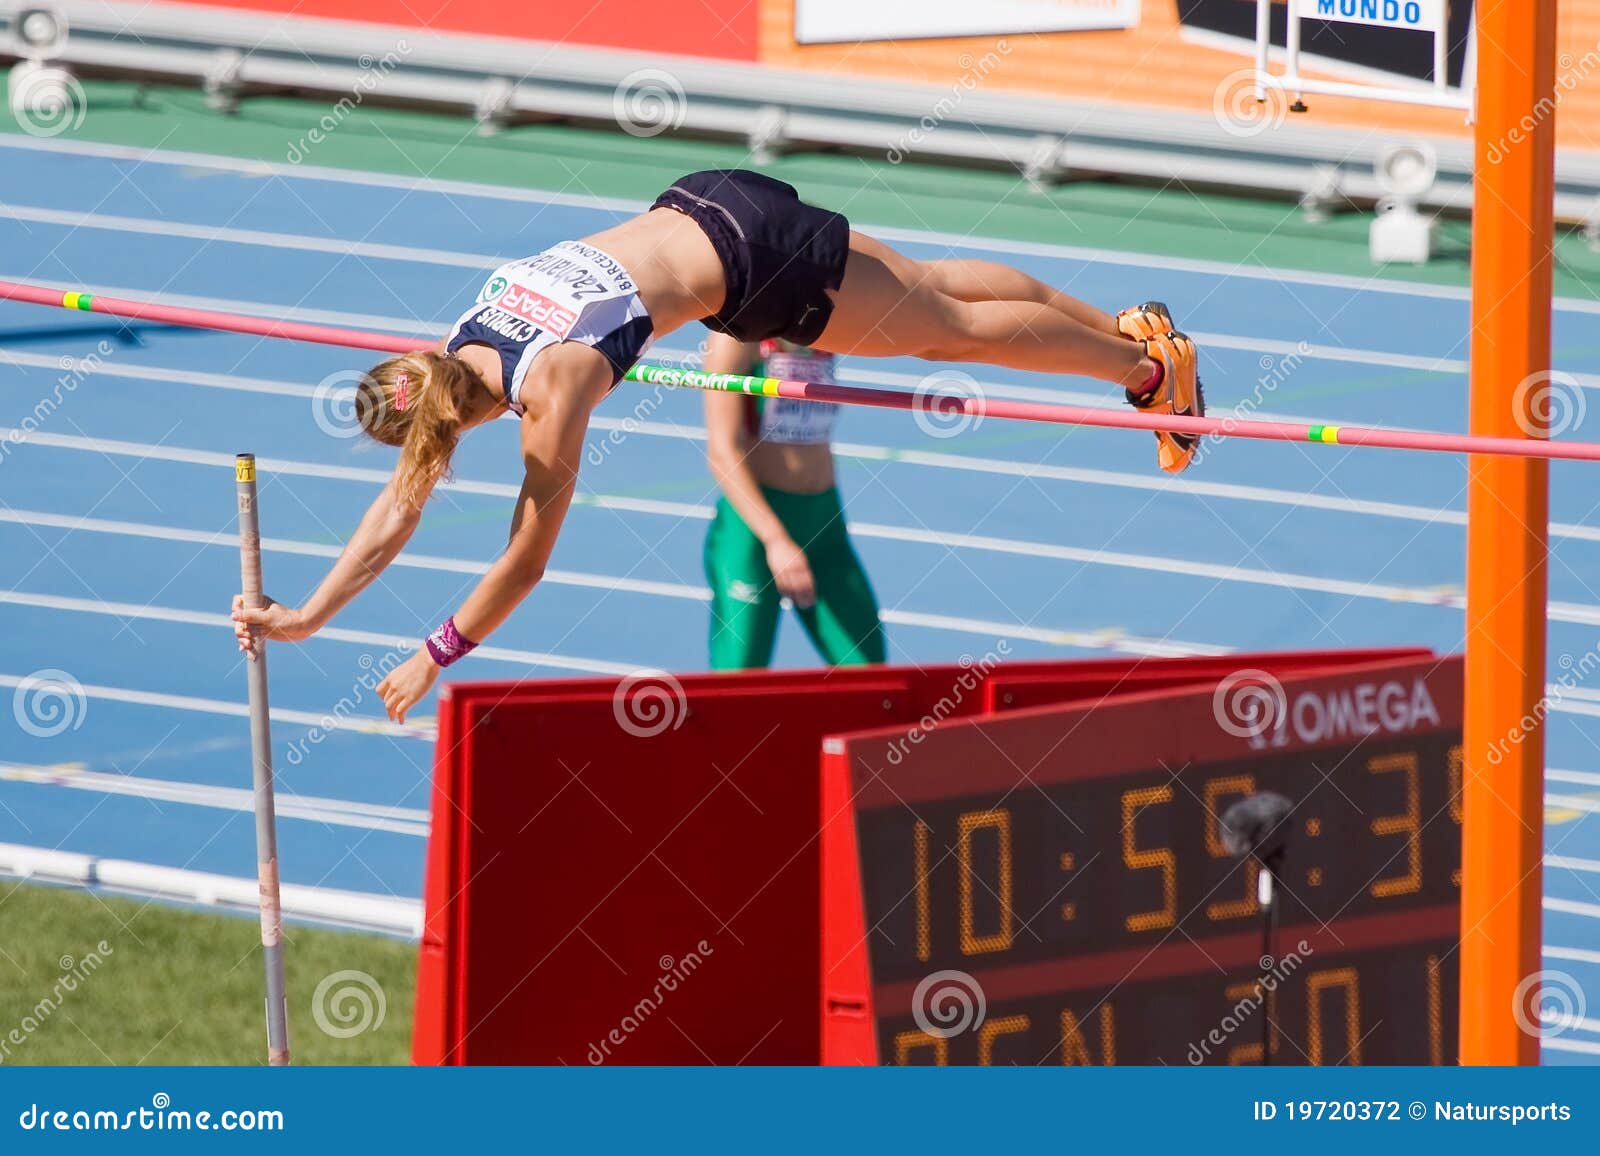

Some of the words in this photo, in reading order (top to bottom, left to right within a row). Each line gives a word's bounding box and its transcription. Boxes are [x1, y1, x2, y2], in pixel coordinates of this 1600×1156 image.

[508, 253, 609, 301] Zacharia
[570, 243, 634, 291] BARCELONA
[475, 306, 538, 343] CYPRUS
[501, 286, 575, 333] SPAR
[1292, 676, 1440, 744] OMEGA
